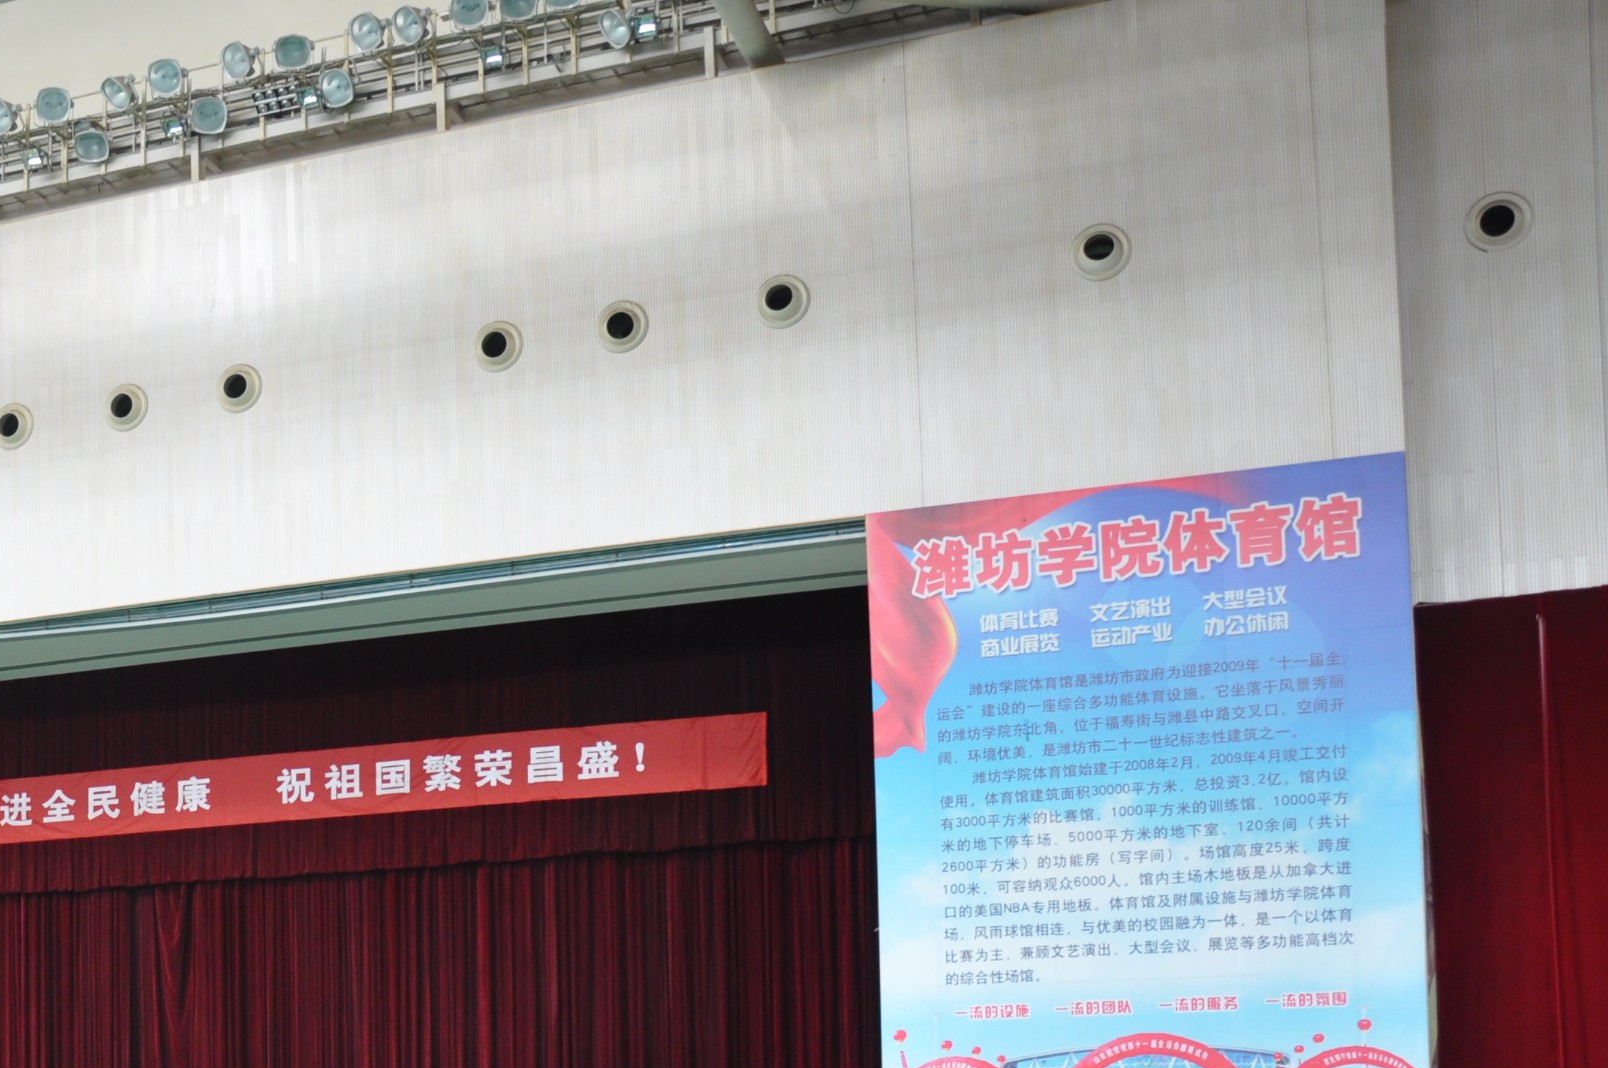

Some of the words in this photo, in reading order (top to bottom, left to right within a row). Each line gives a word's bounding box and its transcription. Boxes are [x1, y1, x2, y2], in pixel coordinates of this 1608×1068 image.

[910, 492, 1361, 599] 潍坊学院体育馆
[980, 608, 1059, 633] 体育比赛
[1090, 597, 1171, 622] 文艺演出
[1203, 585, 1287, 611] 大型会议
[980, 634, 1060, 658] 商业展览
[1091, 623, 1172, 648] 运动产业
[1204, 611, 1288, 637] 办公休闲
[276, 740, 645, 804] 祝祖国繁荣昌盛！
[955, 1004, 1030, 1019] 一流的设施
[1055, 1000, 1132, 1015] 一流的团队
[1159, 996, 1238, 1011] 一流的服务
[1266, 991, 1348, 1008] 一流的氛围
